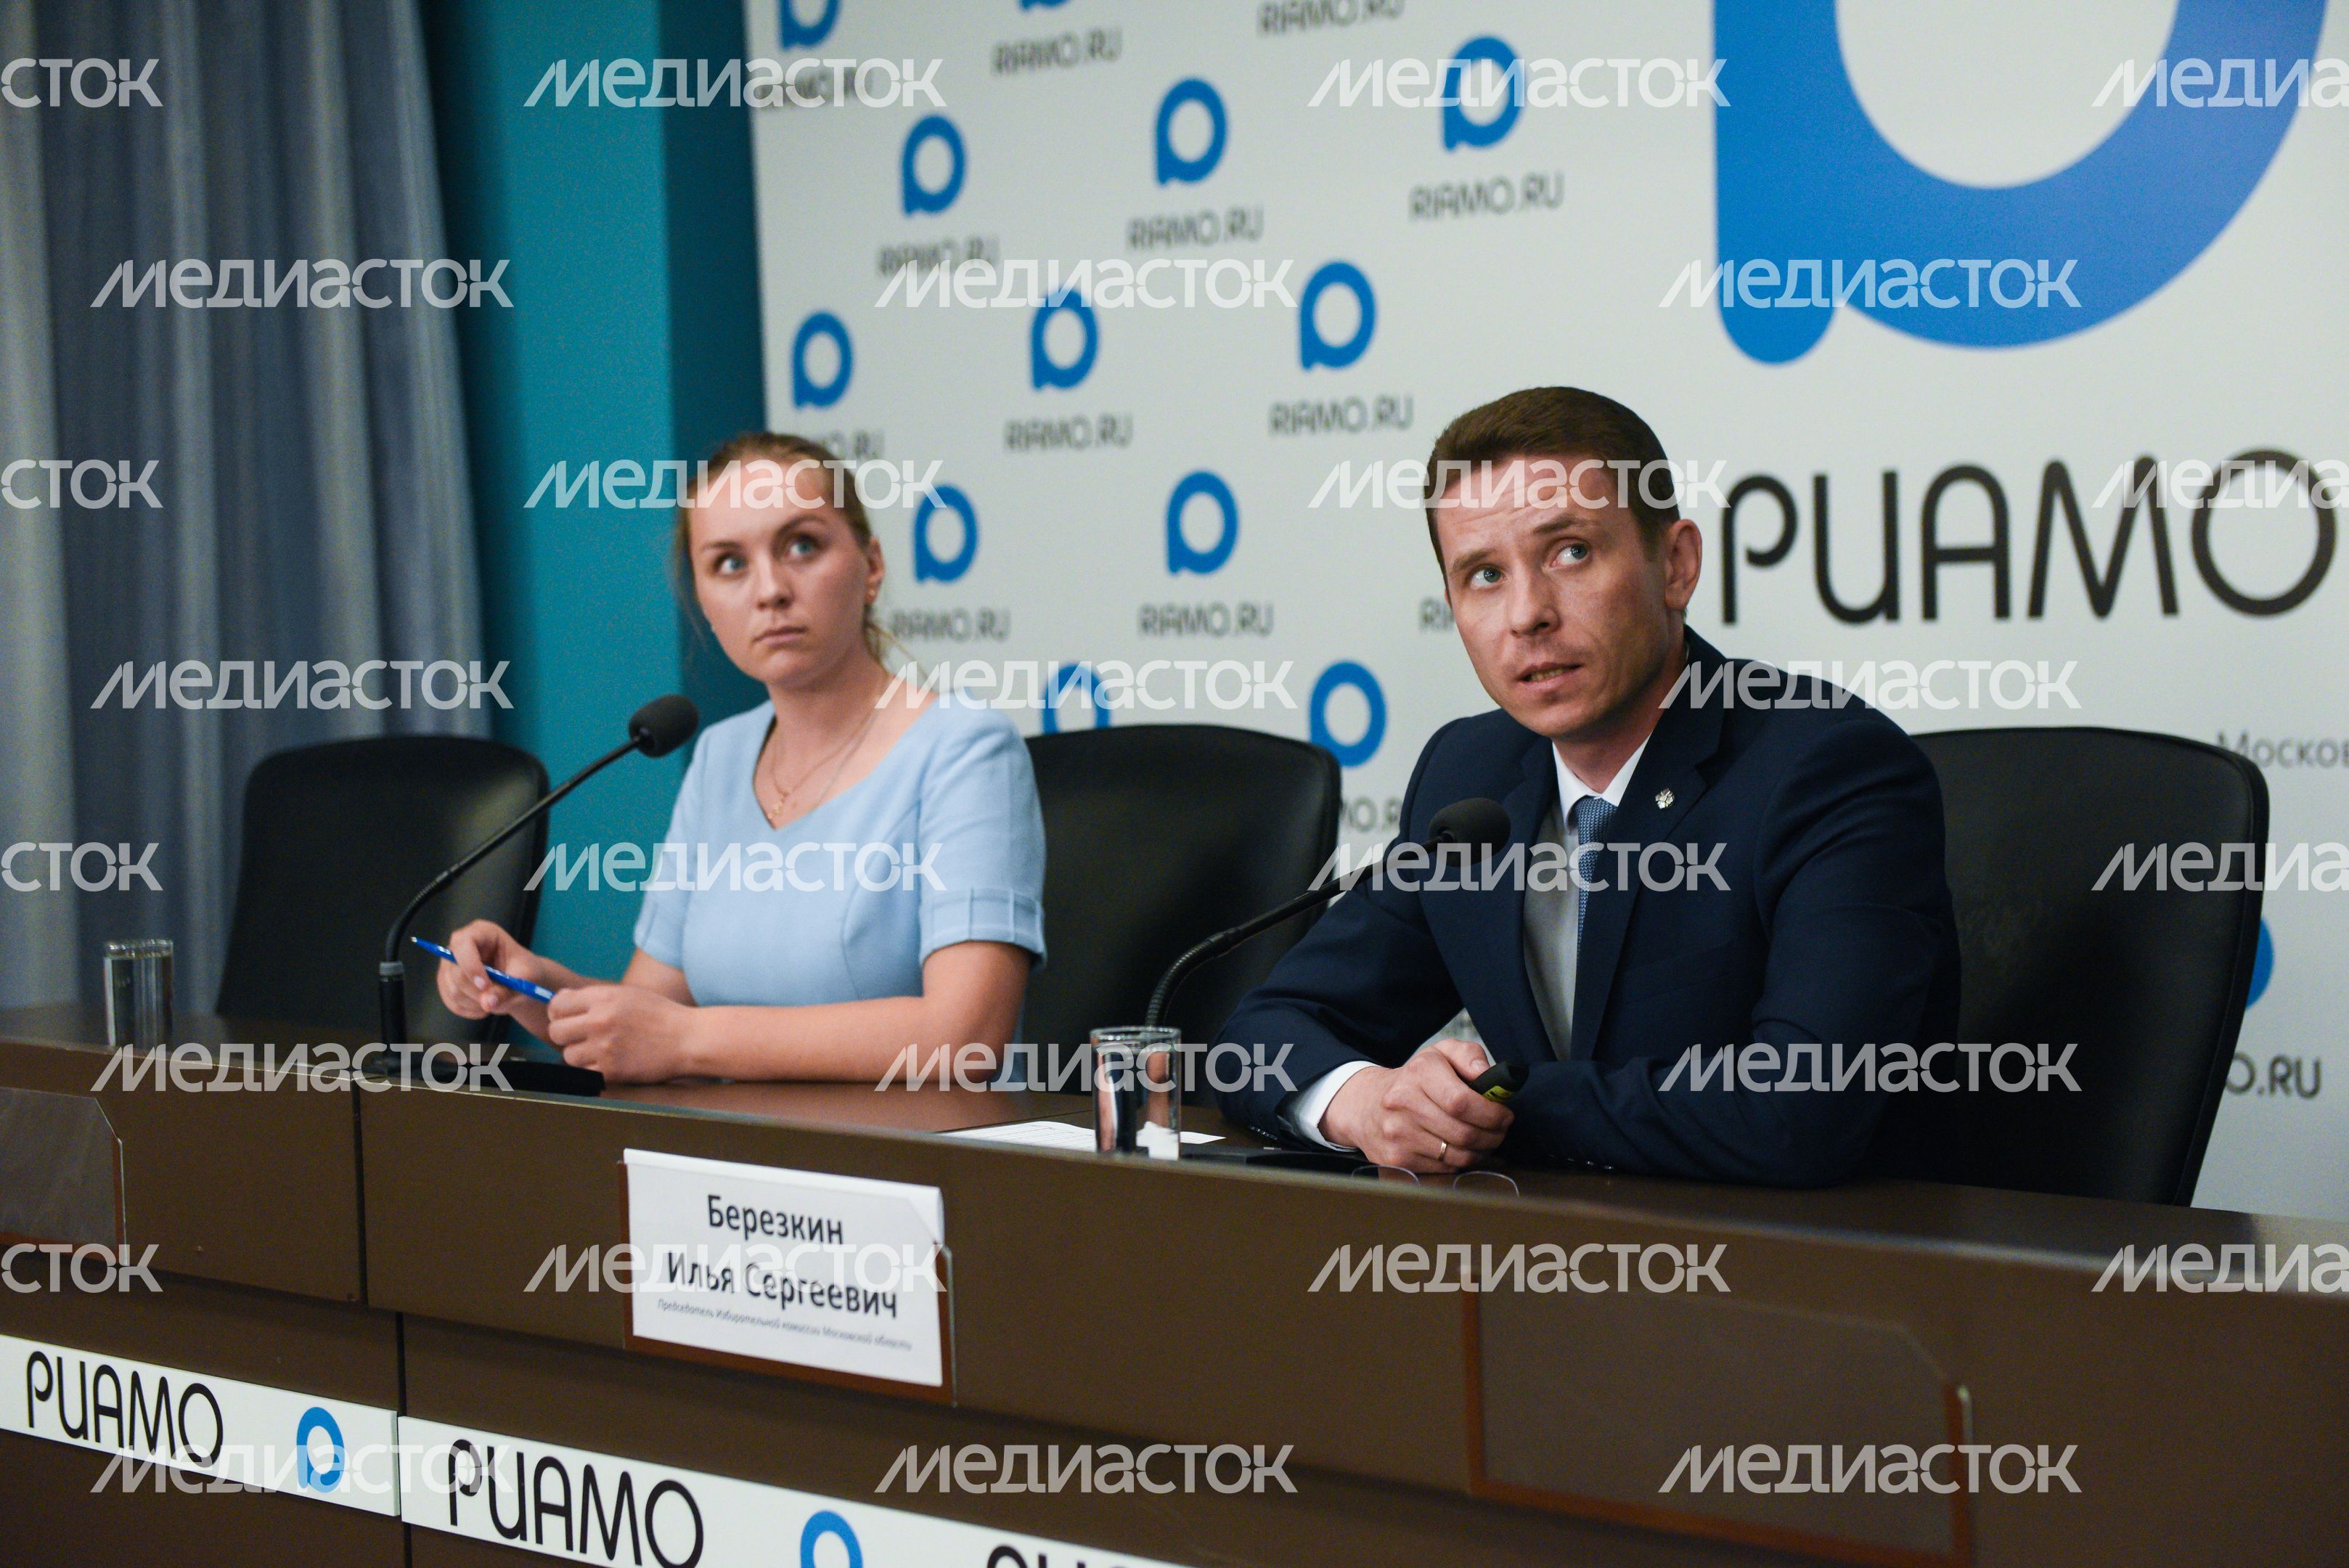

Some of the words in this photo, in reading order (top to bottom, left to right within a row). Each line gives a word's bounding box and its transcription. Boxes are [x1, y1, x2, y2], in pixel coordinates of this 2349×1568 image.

[992, 28, 1122, 73] RIAMO.RU
[1408, 172, 1564, 219] RIAMO.RU
[1127, 206, 1265, 250] RIAMO.RU
[1004, 414, 1132, 451] RIAMO.RU
[1268, 395, 1414, 435] RIAMO.RU
[891, 607, 1011, 642] RIAMO.RU
[1137, 600, 1274, 637] RIAMO.RU
[708, 1194, 843, 1245] Березкин
[667, 1251, 735, 1294] Илья
[745, 1263, 898, 1318] Сергеевич
[26, 1350, 224, 1468] РИАМО
